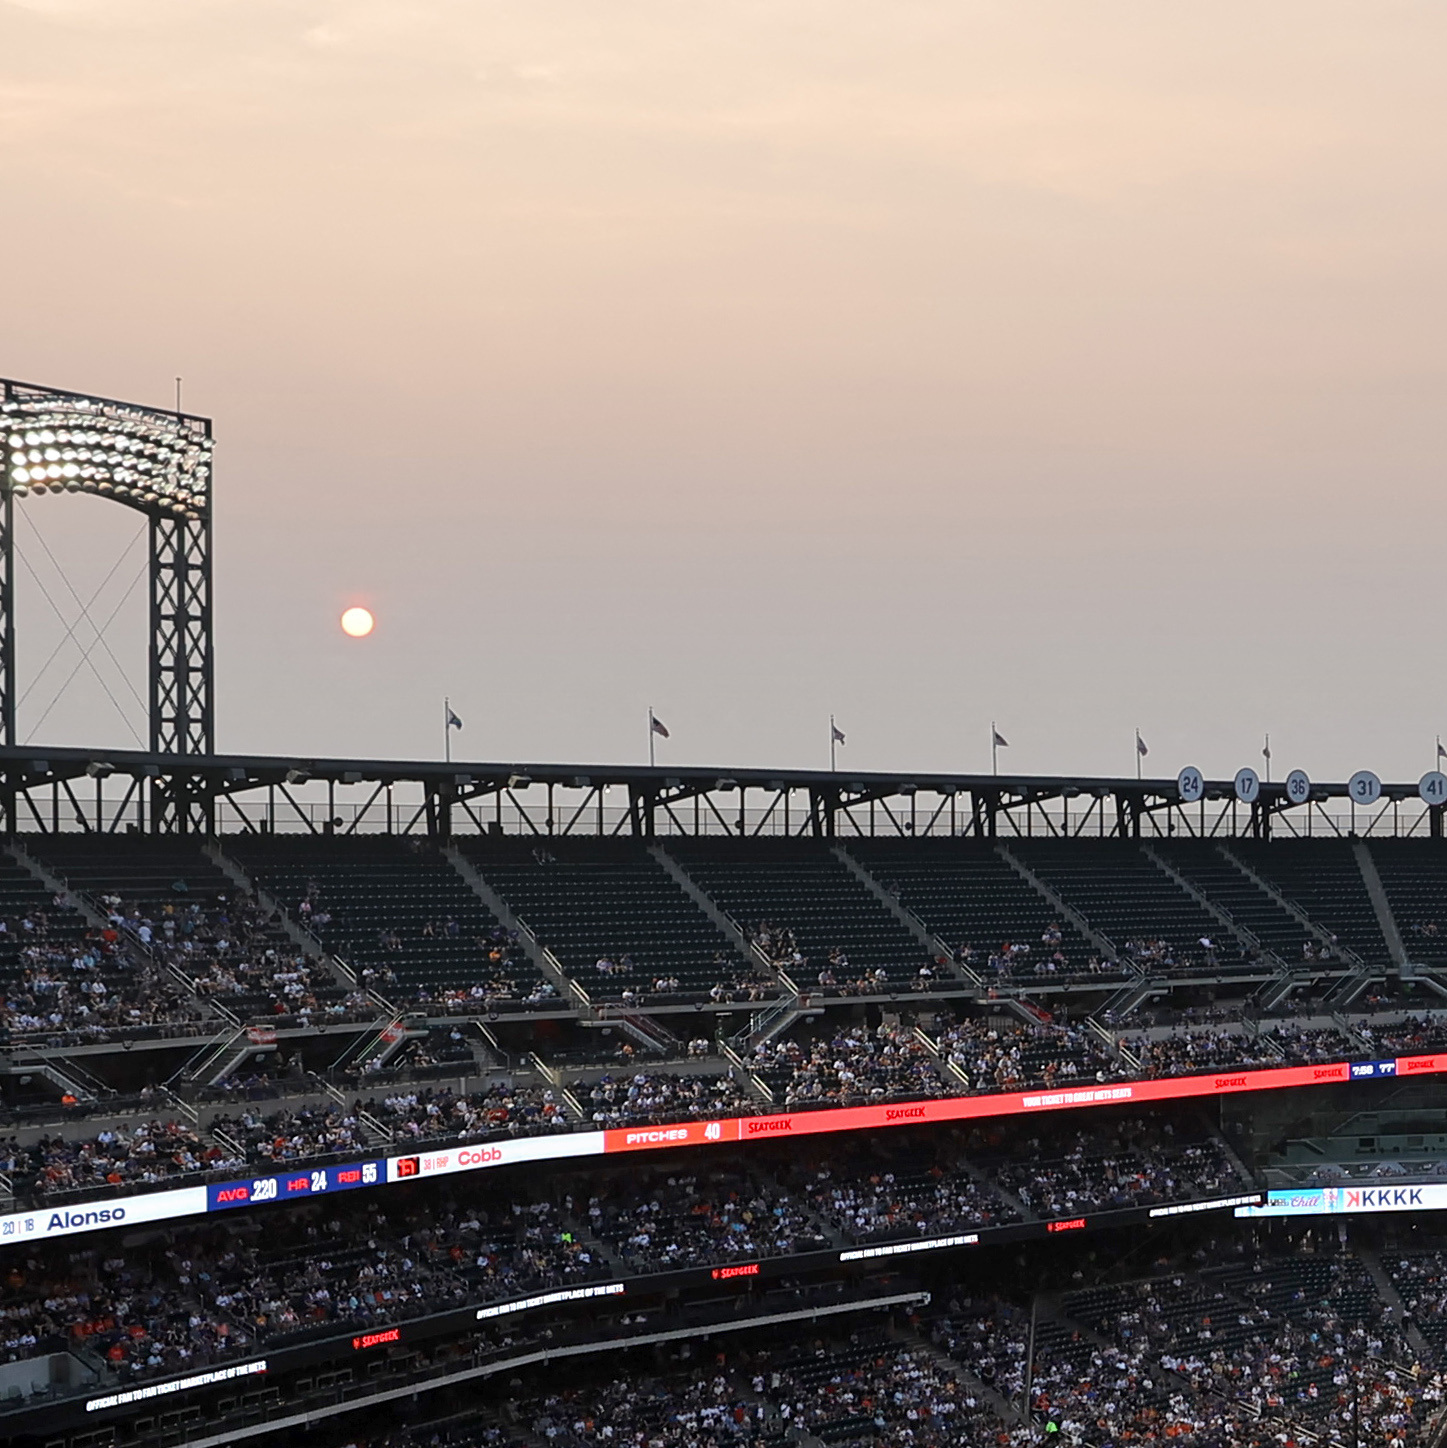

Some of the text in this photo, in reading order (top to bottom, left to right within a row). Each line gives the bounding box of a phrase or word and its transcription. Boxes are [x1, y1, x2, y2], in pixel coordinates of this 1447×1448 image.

[1183, 776, 1199, 793] 24
[1241, 778, 1253, 793] 17
[1291, 777, 1305, 794] 36
[1357, 779, 1372, 795] 31
[1427, 779, 1443, 795] 41
[886, 1107, 925, 1120] SEATGEEK
[627, 1123, 720, 1145] PITCHES 40
[749, 1119, 791, 1133] SEATGEEK
[458, 1147, 502, 1166] Cobb
[217, 1187, 248, 1202] AVG
[250, 1179, 277, 1201] .220
[288, 1178, 309, 1191] HR
[312, 1172, 327, 1191] 24
[338, 1171, 360, 1183] RBI
[363, 1163, 377, 1183] 55
[3, 1222, 15, 1234] 20
[48, 1207, 125, 1231] Alonso
